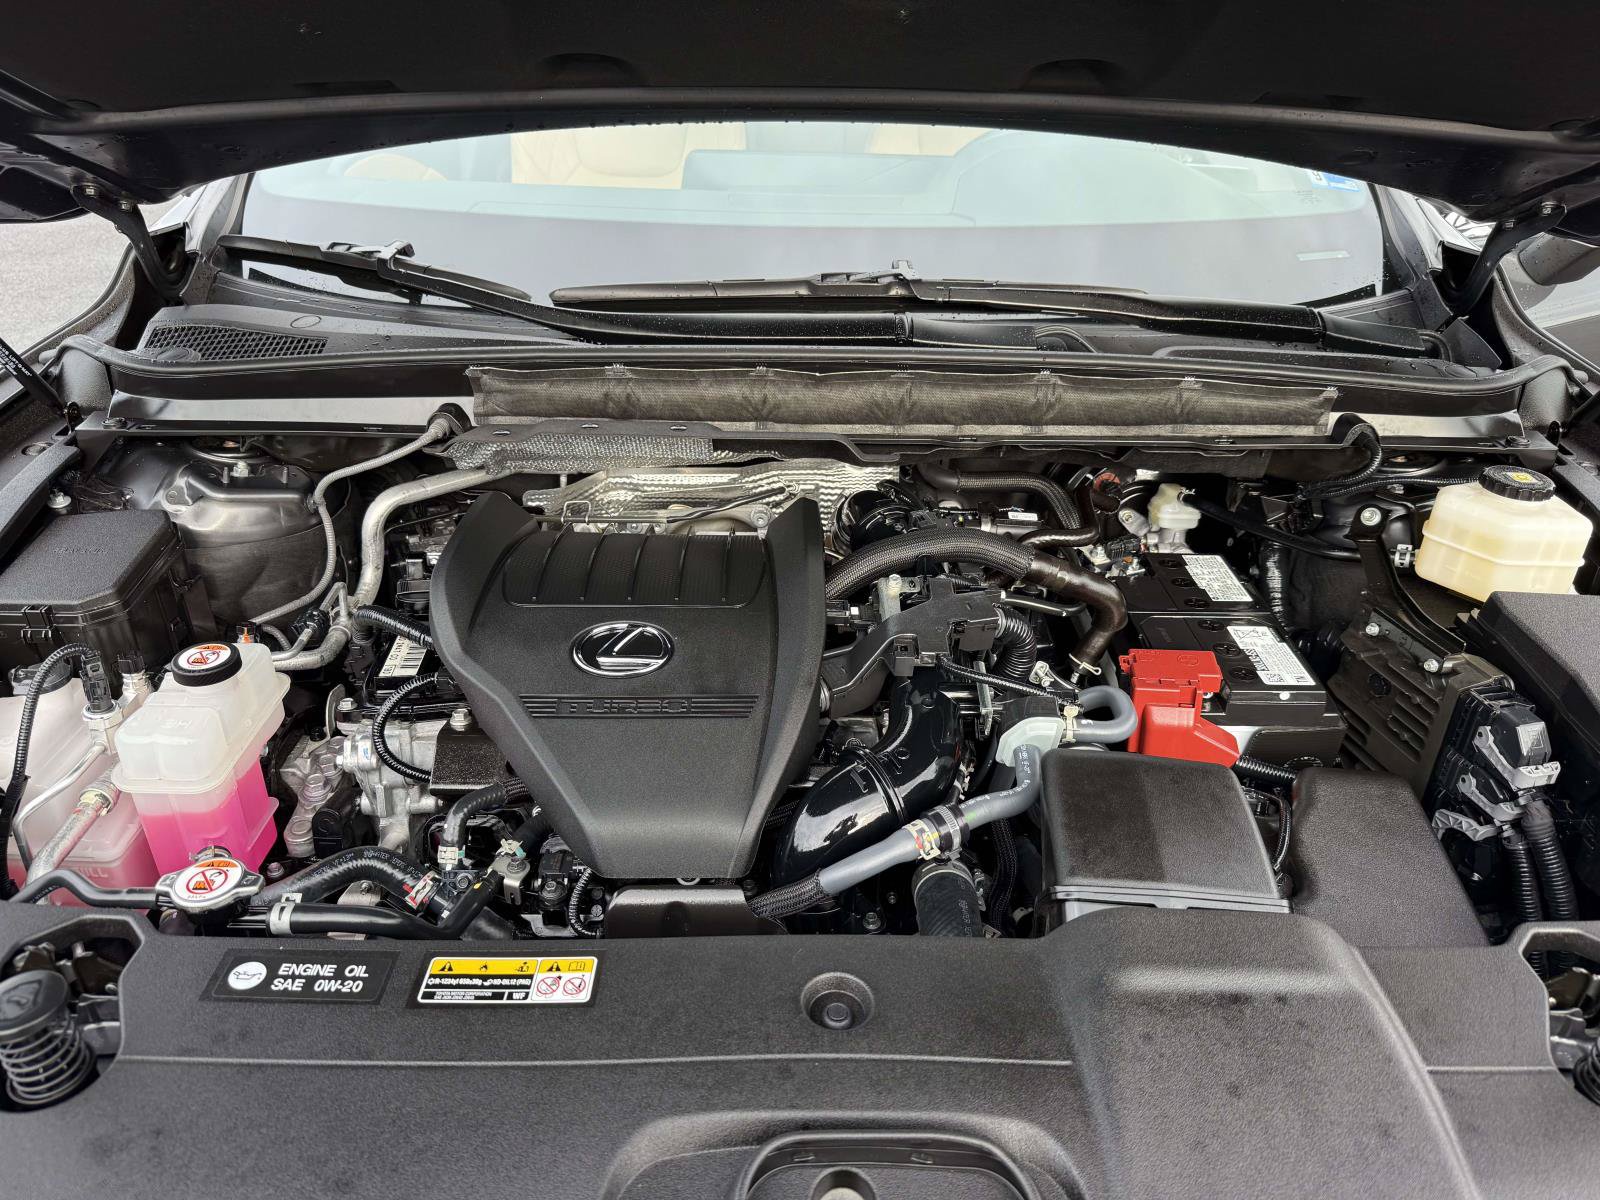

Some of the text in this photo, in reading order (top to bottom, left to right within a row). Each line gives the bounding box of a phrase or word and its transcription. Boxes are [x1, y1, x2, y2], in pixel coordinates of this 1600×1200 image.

[556, 697, 692, 714] TURBO
[278, 963, 369, 978] ENGINE OIL
[270, 977, 364, 993] SAE 0W-20
